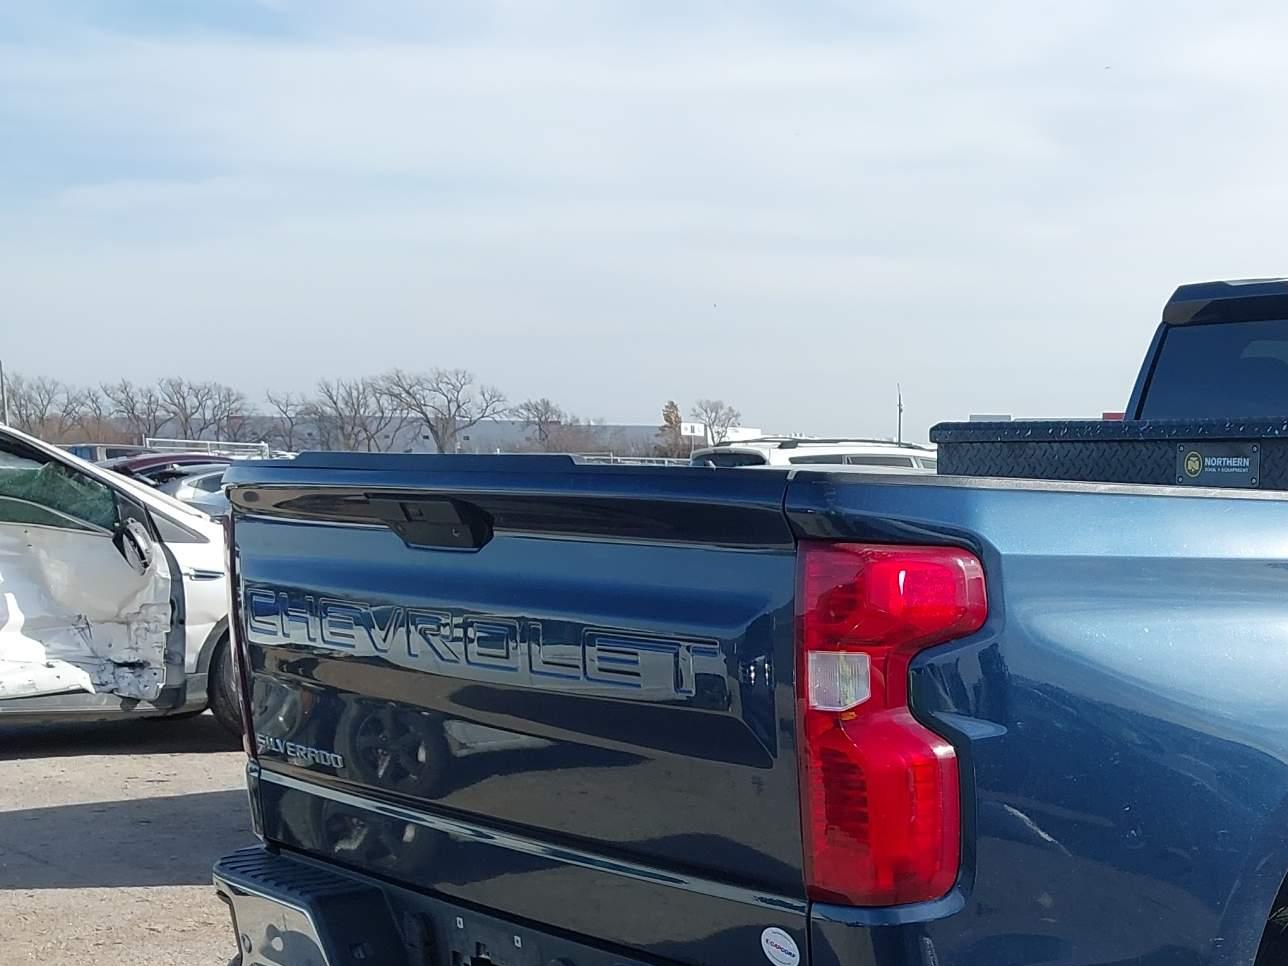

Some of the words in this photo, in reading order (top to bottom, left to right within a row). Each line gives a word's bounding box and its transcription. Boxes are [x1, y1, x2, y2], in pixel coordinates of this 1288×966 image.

[1204, 456, 1250, 467] NORTHERN
[246, 587, 719, 697] CHEVROLET
[256, 734, 344, 769] SILVERADO
